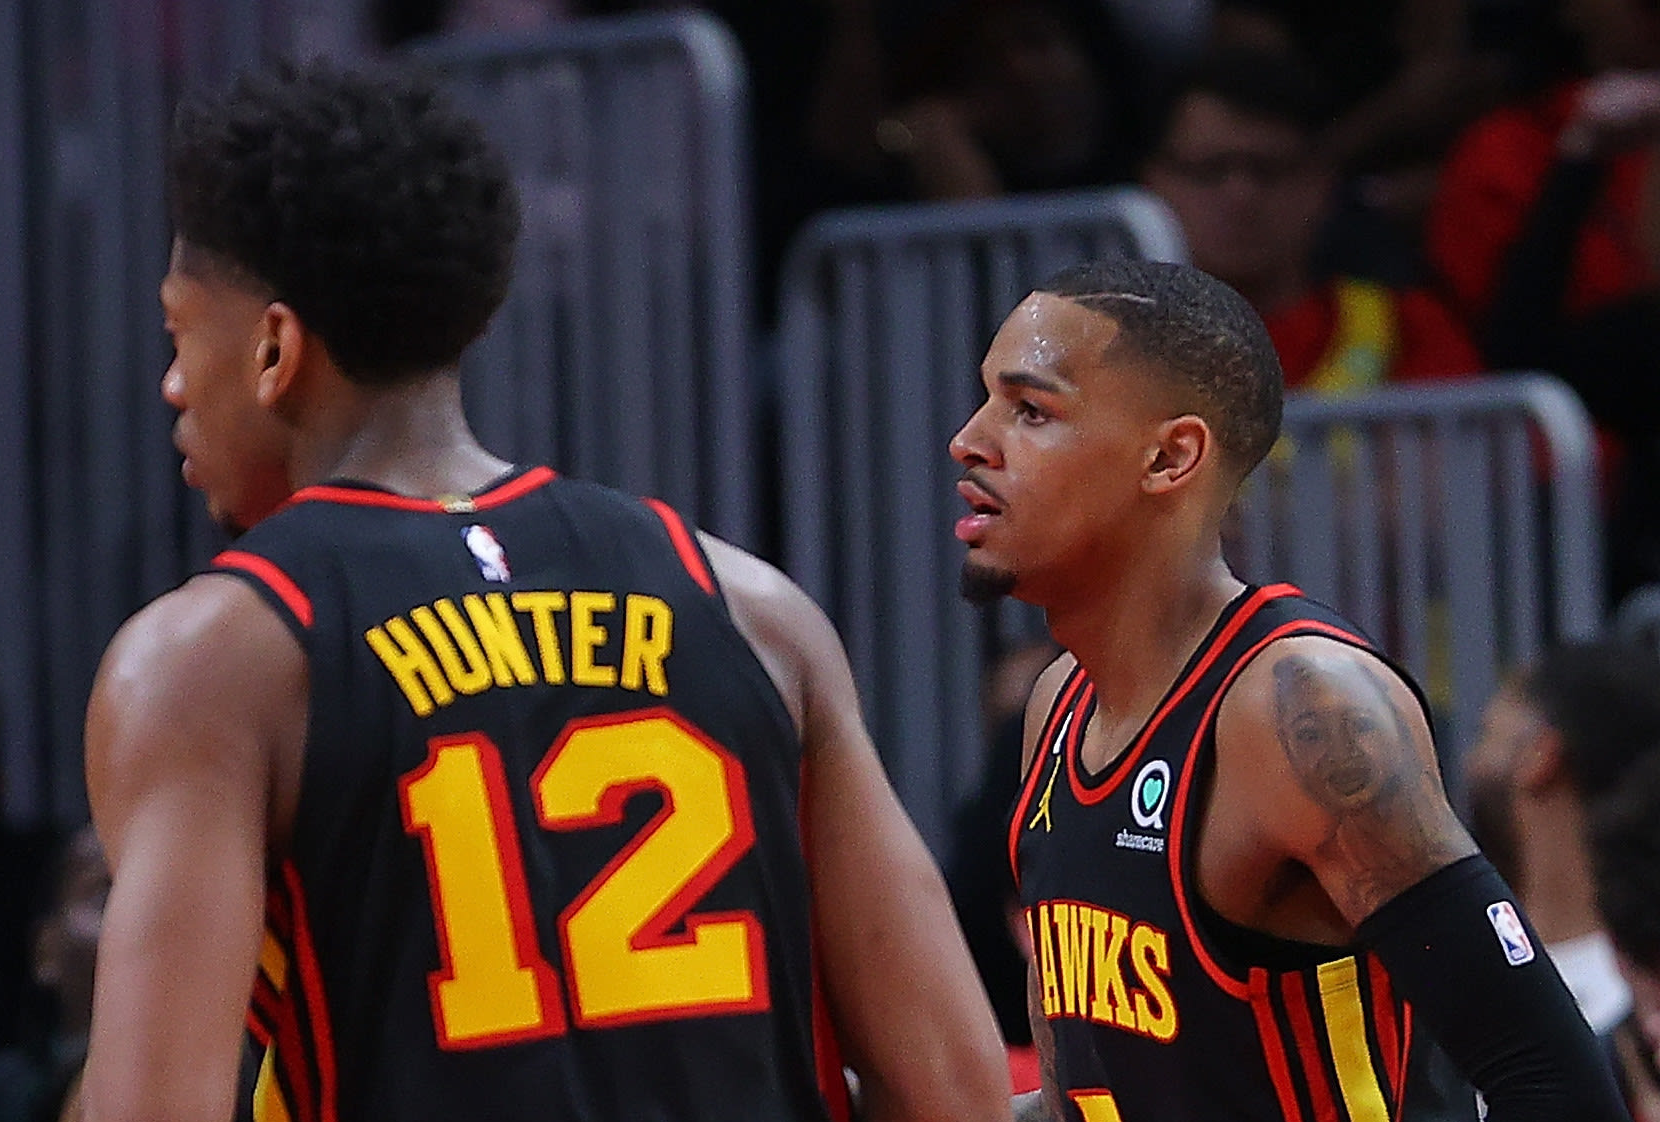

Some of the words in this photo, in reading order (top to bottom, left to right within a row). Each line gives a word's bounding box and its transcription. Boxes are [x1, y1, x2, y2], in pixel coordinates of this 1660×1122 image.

[365, 590, 674, 716] HUNTER
[398, 706, 770, 1050] 12
[1024, 898, 1180, 1043] AWKS
